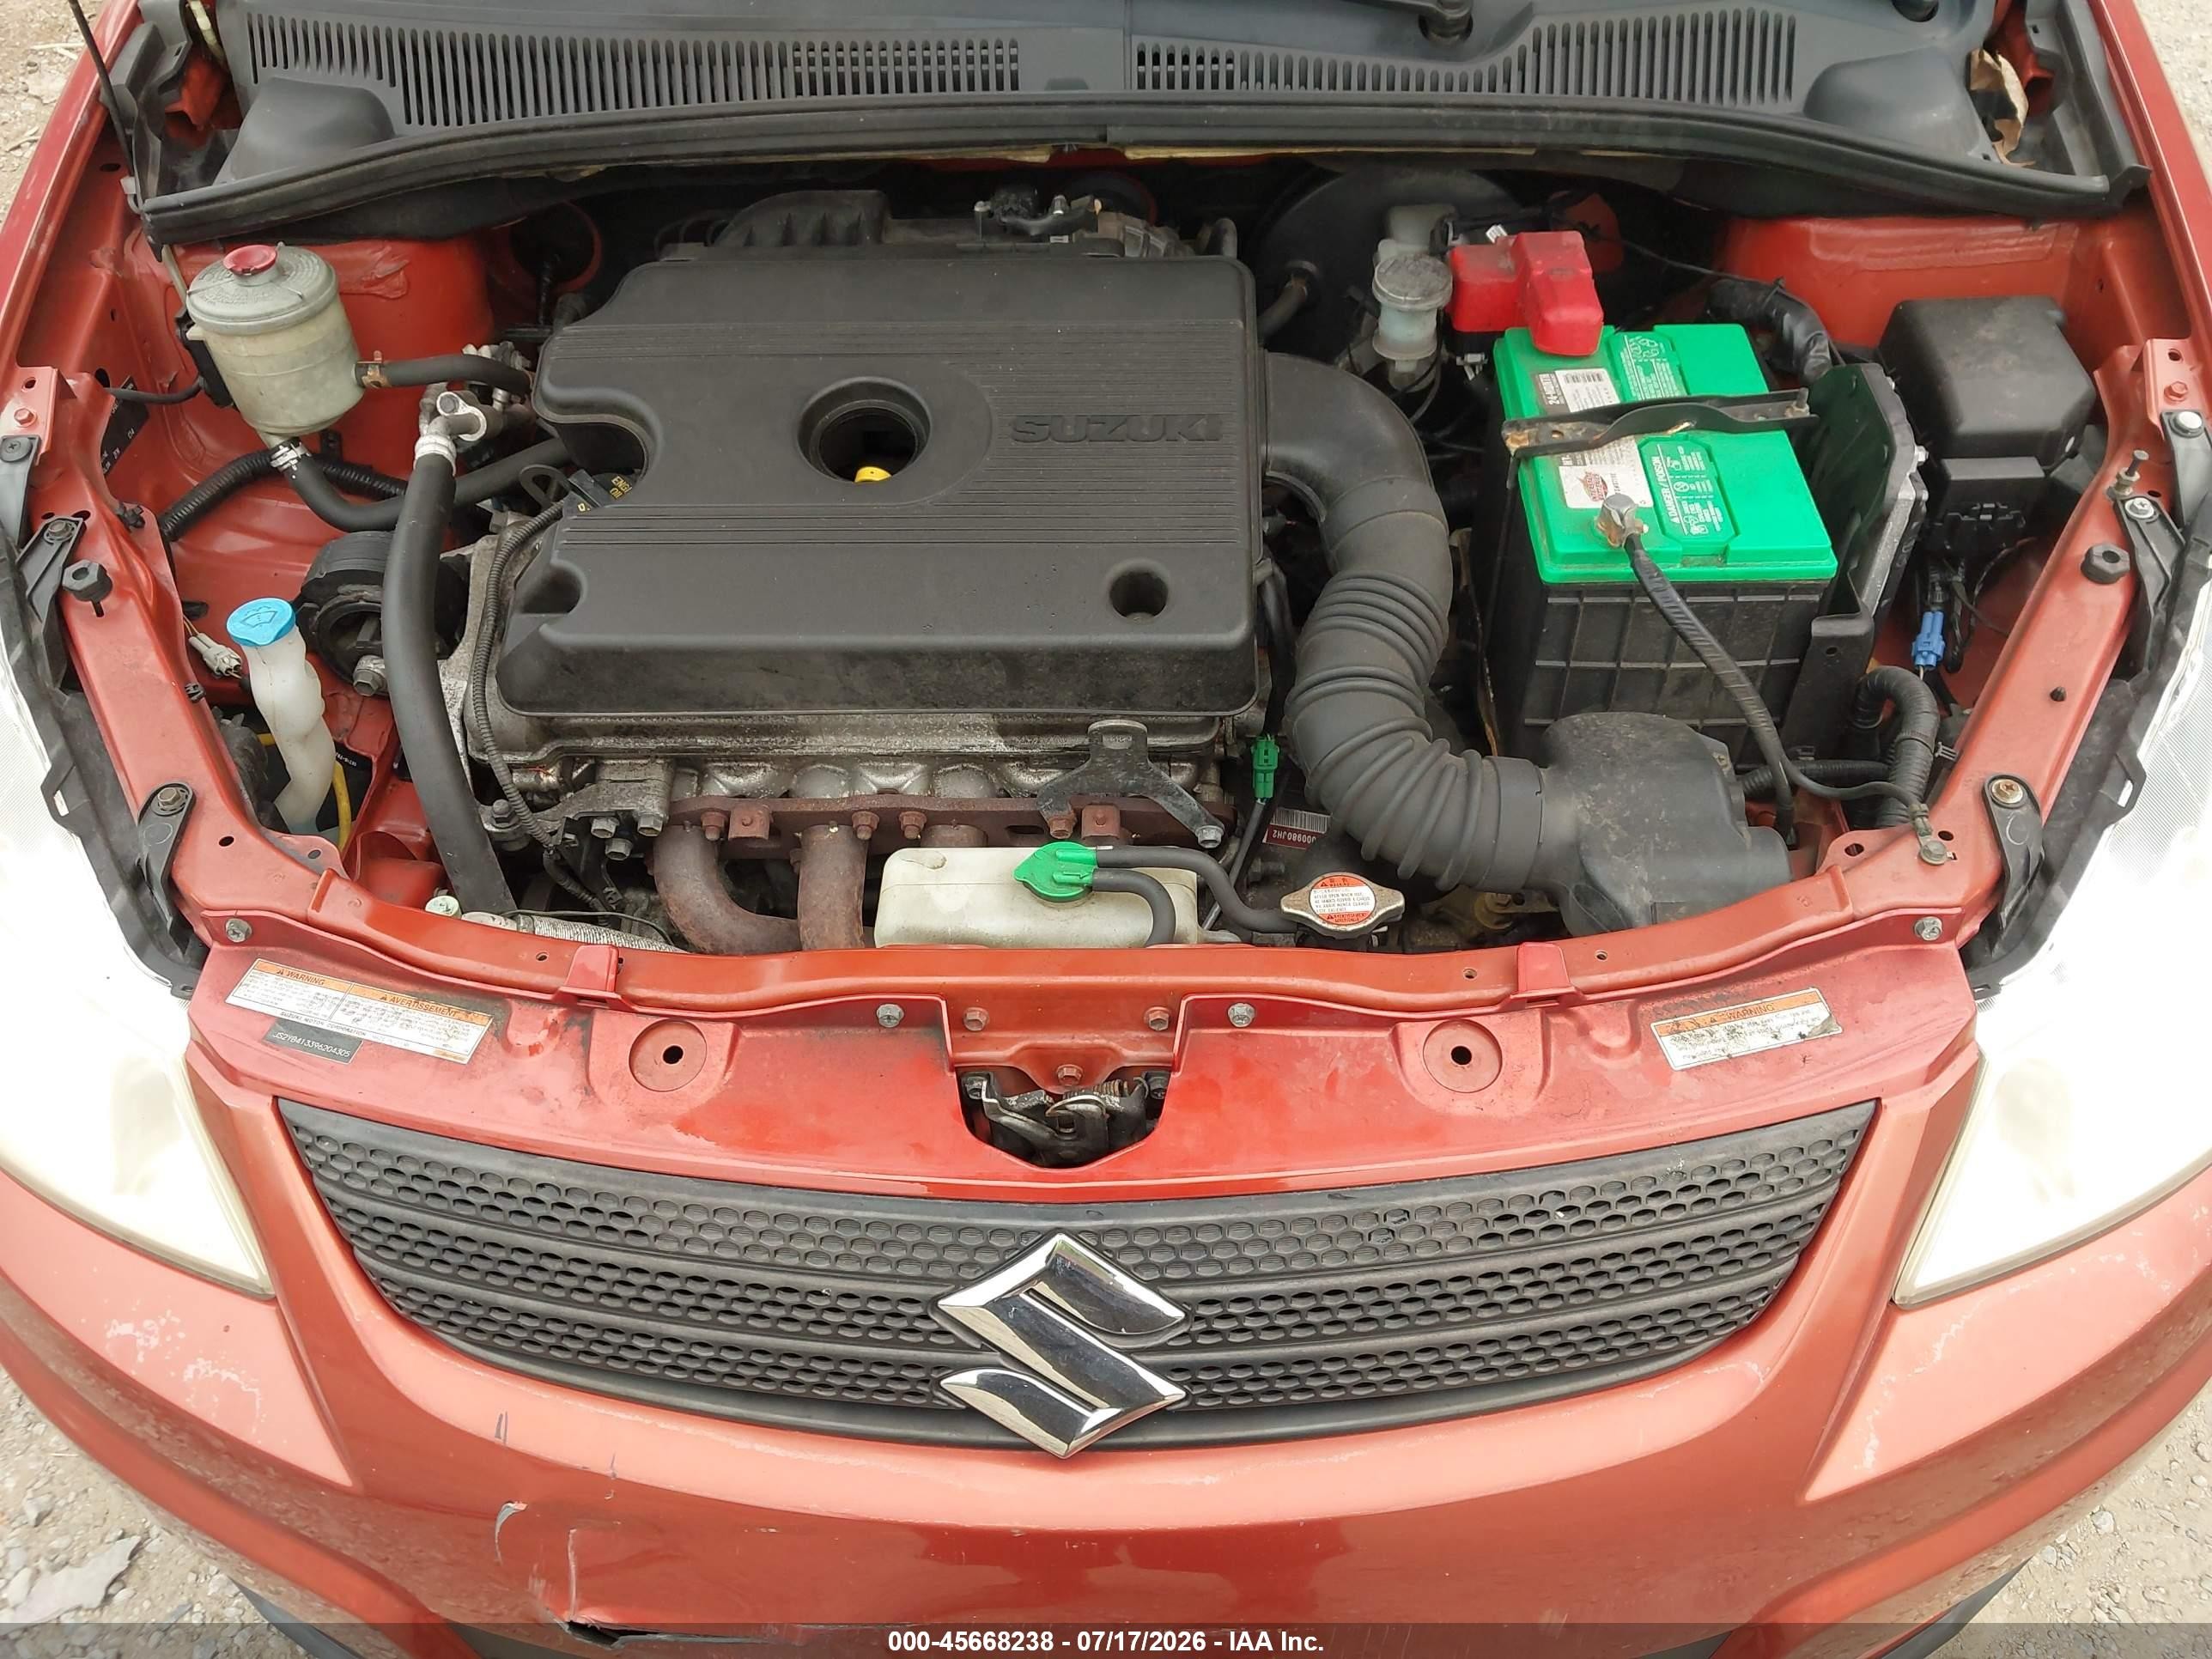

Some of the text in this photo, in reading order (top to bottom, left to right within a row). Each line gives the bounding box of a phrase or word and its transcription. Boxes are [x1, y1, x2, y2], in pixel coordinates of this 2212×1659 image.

[1012, 415, 1223, 443] SUZUKI
[1651, 456, 1667, 482] POISON
[610, 487, 623, 500] OIL
[611, 476, 633, 494] ENGI
[1662, 488, 1678, 520] DANGER
[286, 969, 326, 987] WARNING
[390, 995, 458, 1018] AVERTISSEMENT
[1728, 1003, 1775, 1021] WARNING
[280, 1012, 302, 1022] SUZUKI
[304, 1018, 325, 1026] MOTOR
